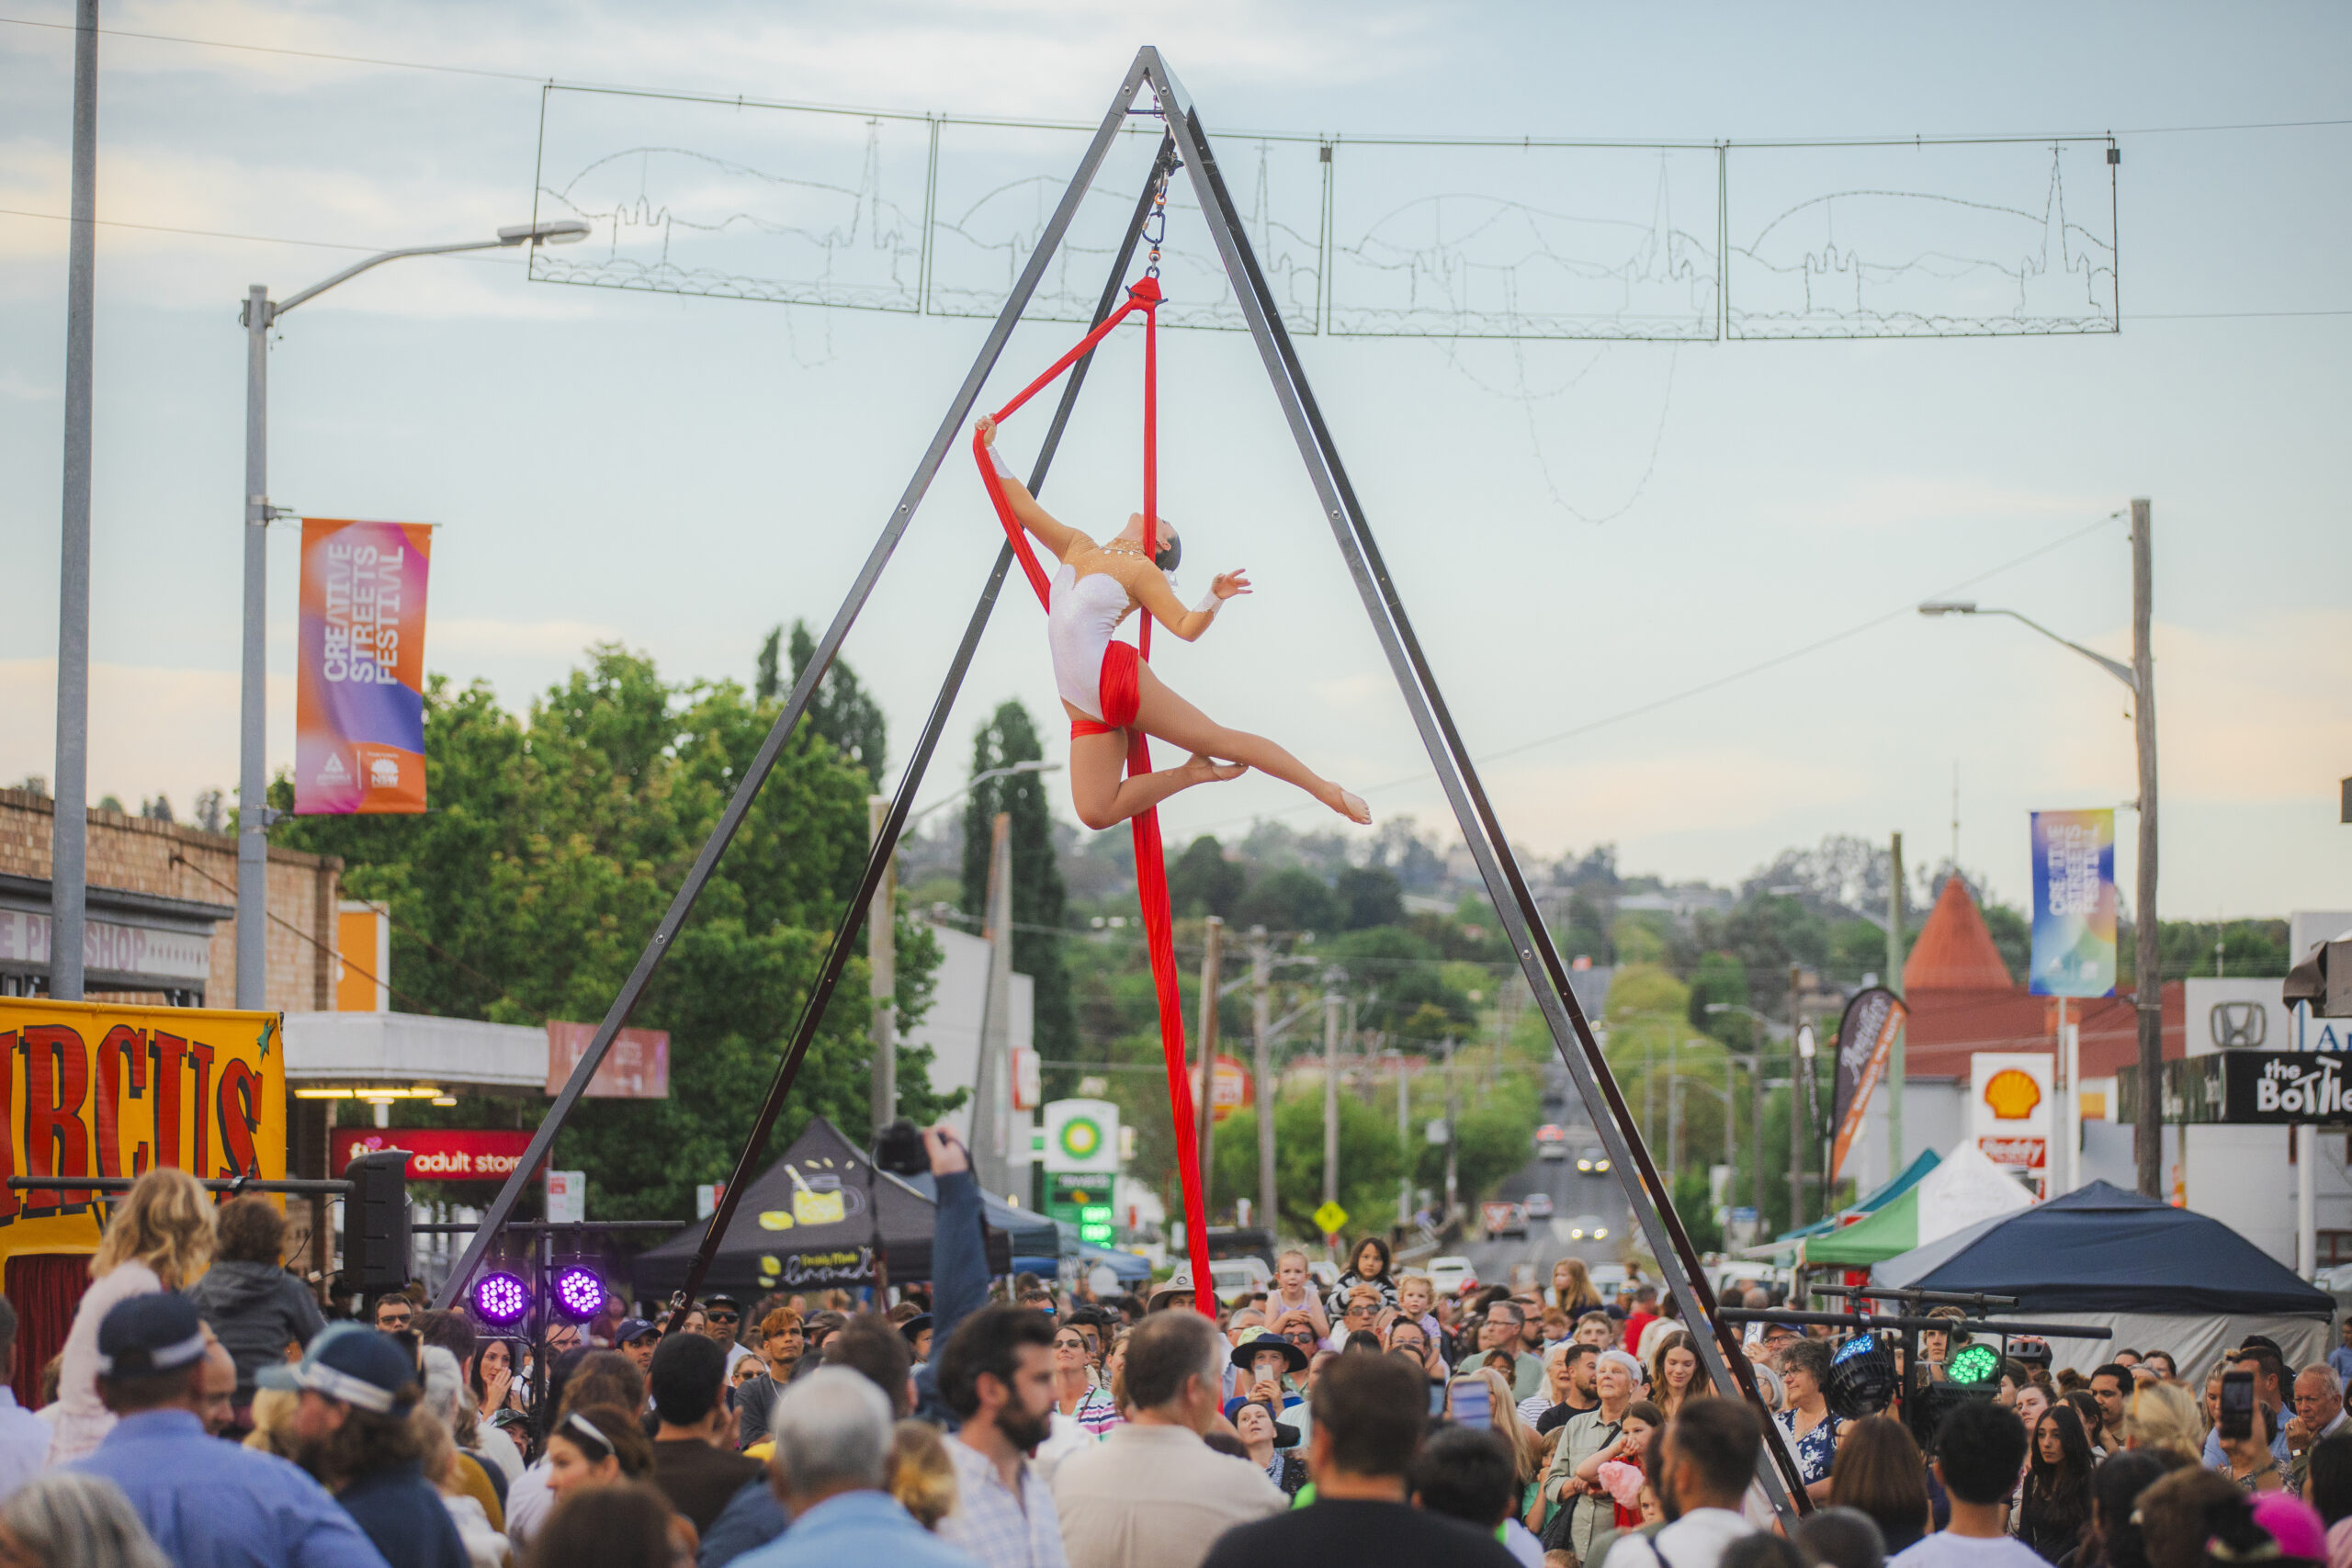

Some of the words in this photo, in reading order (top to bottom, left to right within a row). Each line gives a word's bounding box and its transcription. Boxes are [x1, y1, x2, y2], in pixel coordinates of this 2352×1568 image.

[323, 544, 351, 682] CREATIVE
[349, 545, 378, 683] STREETS
[375, 546, 404, 685] FESTIVAL
[84, 920, 147, 971] SHOP
[2264, 1057, 2301, 1080] the
[413, 1150, 471, 1173] adult
